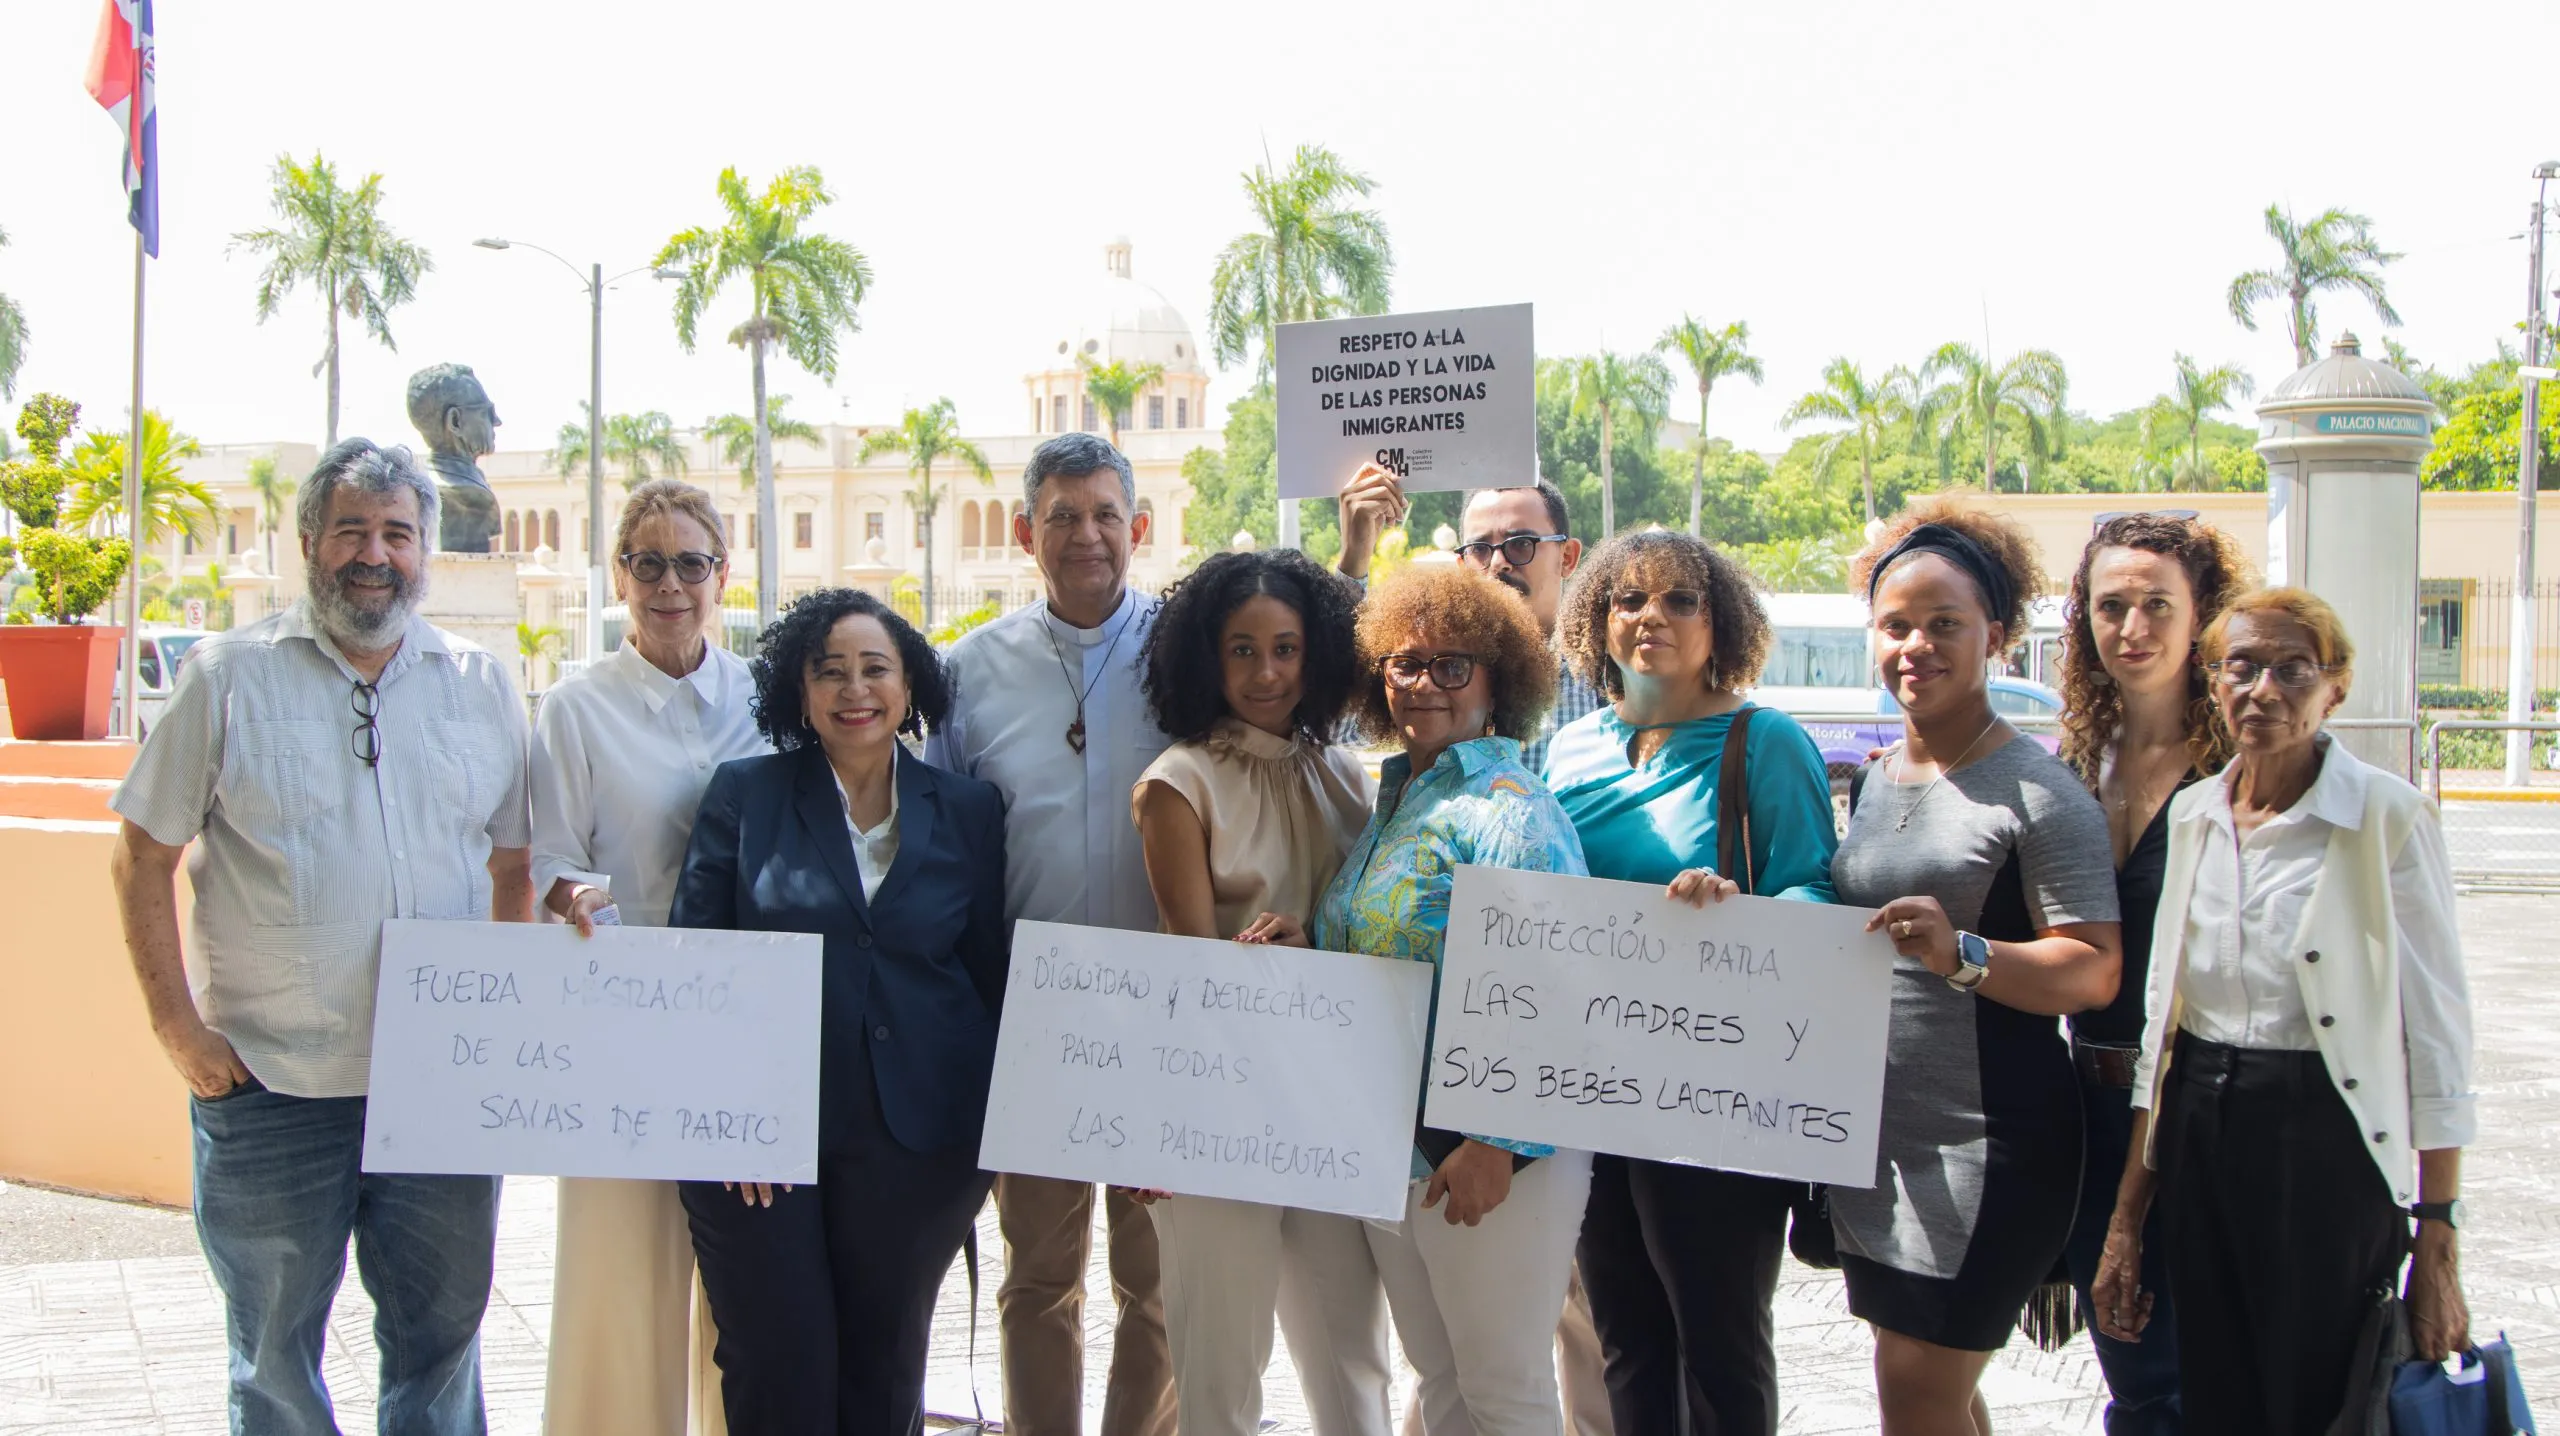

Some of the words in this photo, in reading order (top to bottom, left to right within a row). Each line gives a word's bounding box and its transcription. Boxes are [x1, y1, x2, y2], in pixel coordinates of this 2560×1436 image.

[1340, 331, 1417, 353] RESPETO
[1441, 328, 1465, 346] LA
[1312, 360, 1400, 383] DIGNIDAD
[1406, 359, 1418, 376] Y
[1424, 357, 1448, 375] LA
[1452, 353, 1496, 372] VIDA
[1321, 392, 1344, 410] DE
[1350, 389, 1383, 408] LAS
[1389, 382, 1487, 406] PERSONAS
[1342, 412, 1465, 436] INMIGRANTES
[2330, 416, 2375, 429] PALACIO
[2378, 416, 2419, 430] NACIONAL
[1376, 448, 1404, 465] CM
[1699, 941, 1780, 981] PARA
[406, 965, 522, 1005] FUERA
[1201, 977, 1354, 1027] DERECHOS
[1463, 978, 1539, 1019] LAS
[1586, 993, 1745, 1044] MADRES
[452, 1033, 492, 1066] DE
[516, 1041, 573, 1071] LAS
[1061, 1033, 1123, 1069] PARA
[1153, 1046, 1251, 1083] TODAS
[1443, 1046, 1517, 1093] SUS
[1535, 1064, 1643, 1105] BEBÉS
[1657, 1077, 1851, 1144] LACTANTES
[611, 1104, 649, 1137] DE
[1067, 1106, 1126, 1148] LAS
